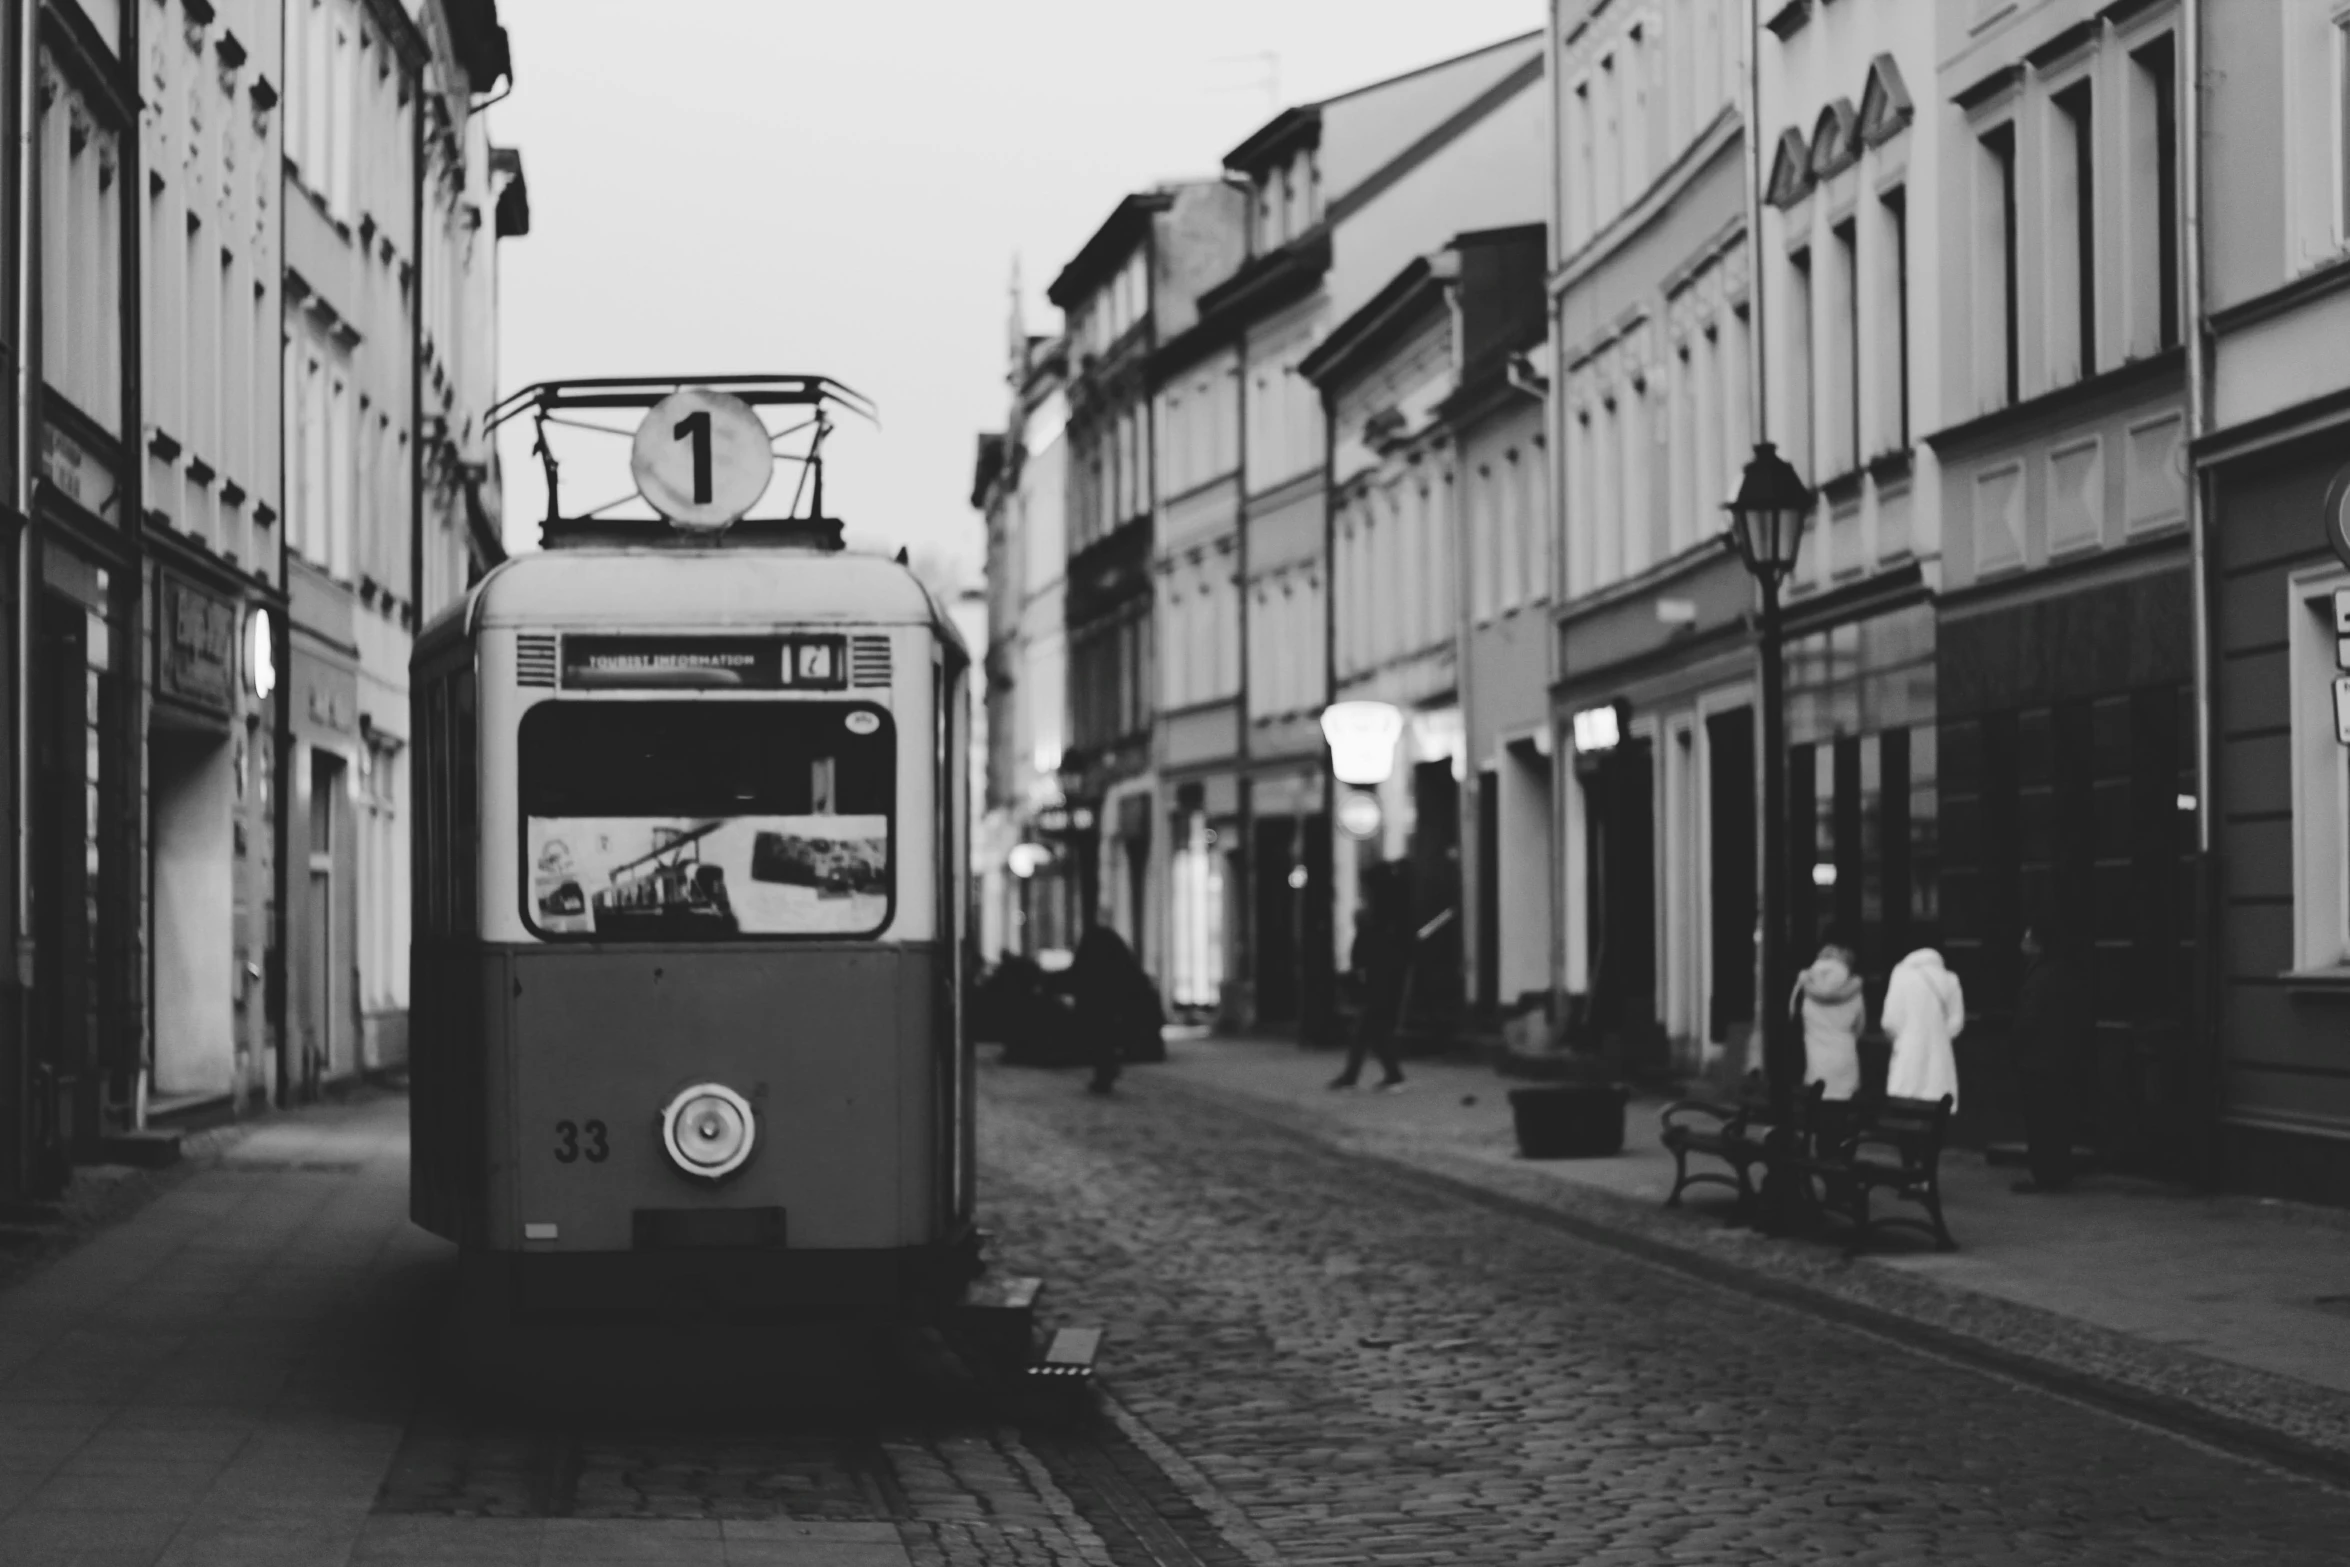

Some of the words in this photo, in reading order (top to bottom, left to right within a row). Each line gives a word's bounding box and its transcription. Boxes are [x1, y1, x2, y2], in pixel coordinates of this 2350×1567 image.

[673, 411, 712, 505] 1
[589, 655, 649, 668] TOURIST
[653, 654, 755, 667] INFORMATION
[554, 1119, 609, 1163] 33
